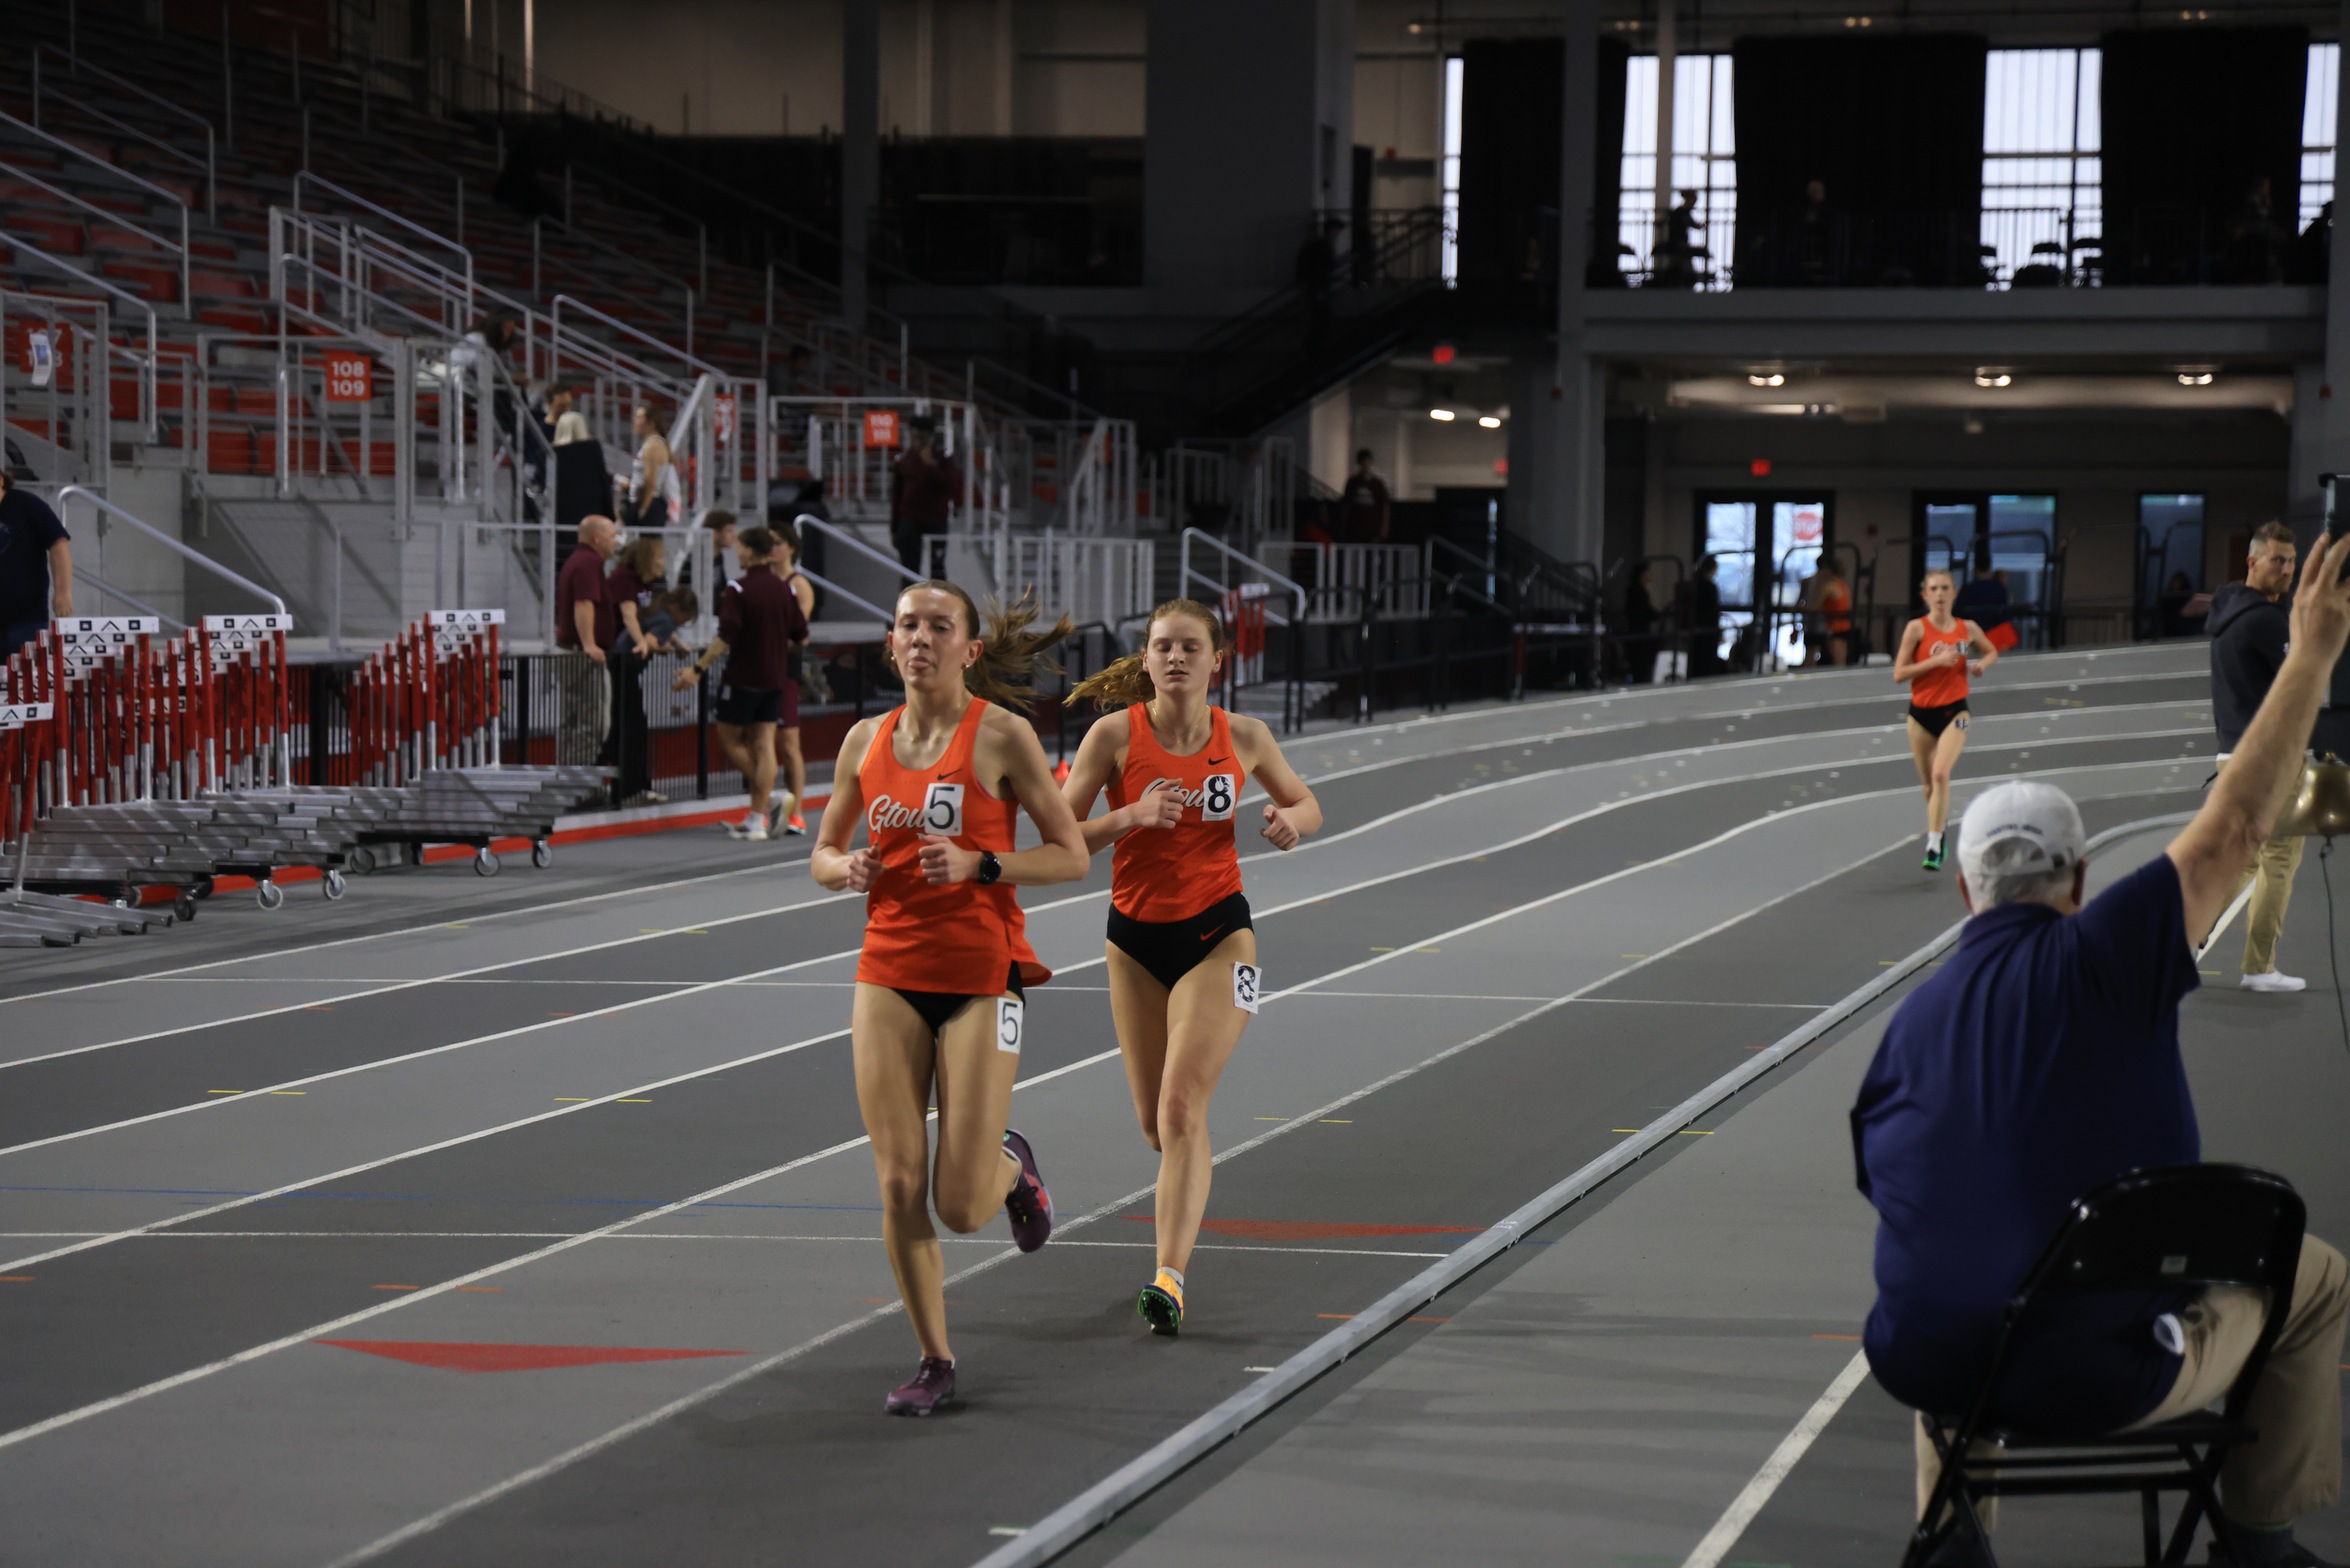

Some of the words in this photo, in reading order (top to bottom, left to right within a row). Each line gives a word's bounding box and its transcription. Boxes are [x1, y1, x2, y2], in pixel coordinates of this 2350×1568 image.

[331, 361, 364, 377] 108
[331, 380, 365, 396] 109
[928, 786, 955, 830] 5
[1207, 775, 1231, 814] 8
[1237, 965, 1256, 1003] 8
[1001, 1001, 1018, 1046] 5
